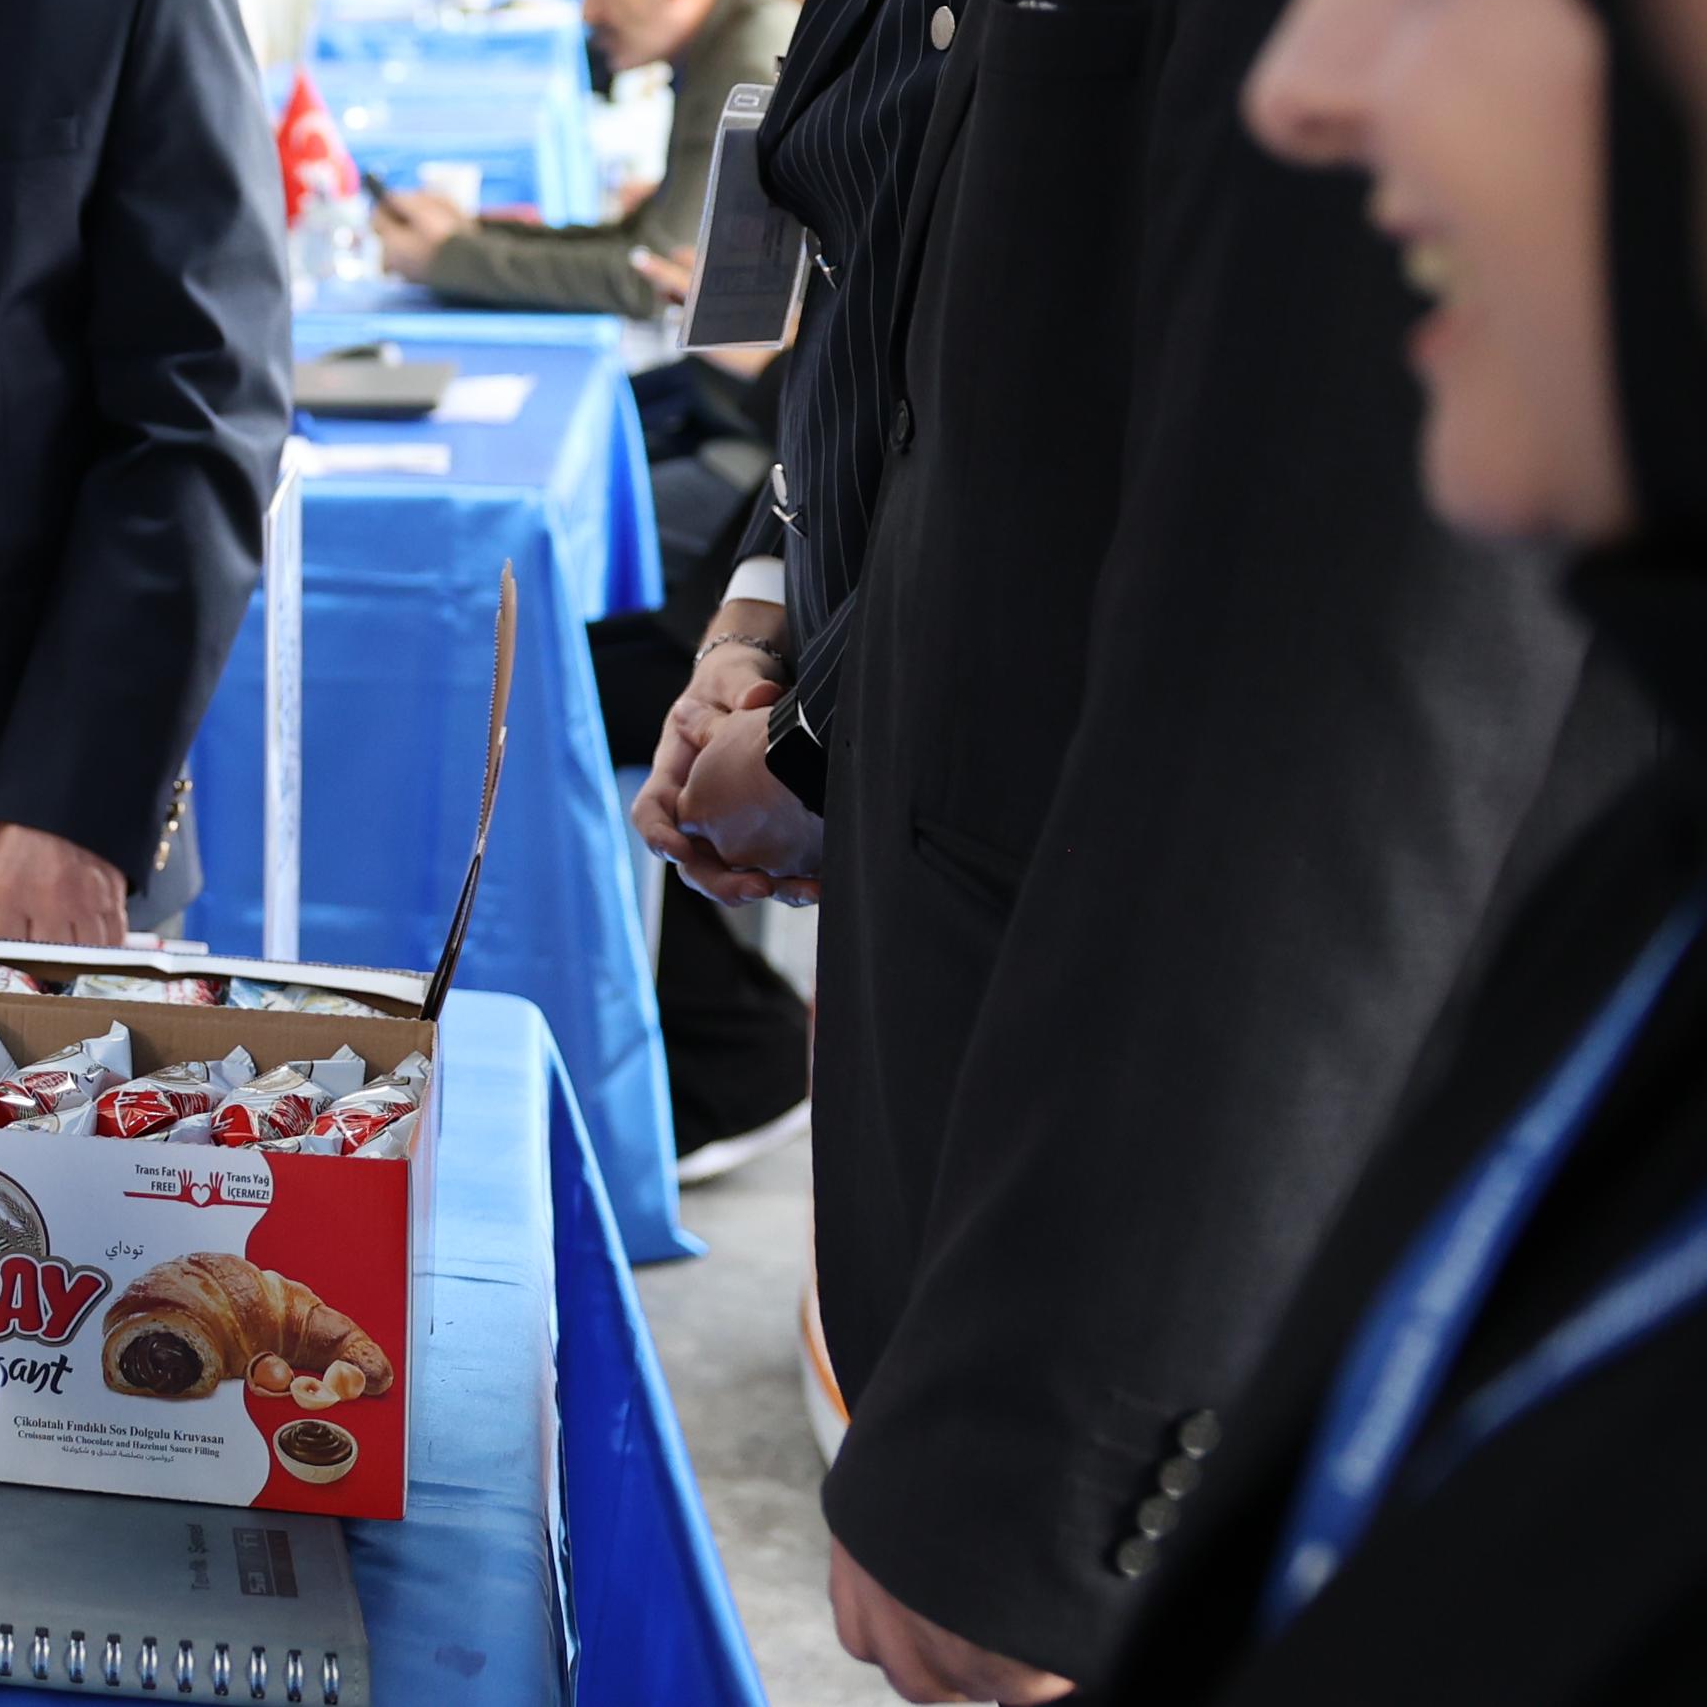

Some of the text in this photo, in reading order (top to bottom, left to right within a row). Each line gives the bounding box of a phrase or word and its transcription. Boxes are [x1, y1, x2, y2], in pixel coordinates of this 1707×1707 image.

[135, 1164, 176, 1177] Trans Fat
[151, 1180, 176, 1192] FREE!
[227, 1172, 270, 1187] Trans Yağ
[227, 1186, 270, 1200] İÇERMEZ!
[105, 1240, 145, 1260] توداي
[13, 1415, 225, 1445] Çikolatalı Fındıklı Sos Dolgulu Kruvasan
[17, 1429, 220, 1458] Croissant with Chocolate and Hazelnut Sauce Filling
